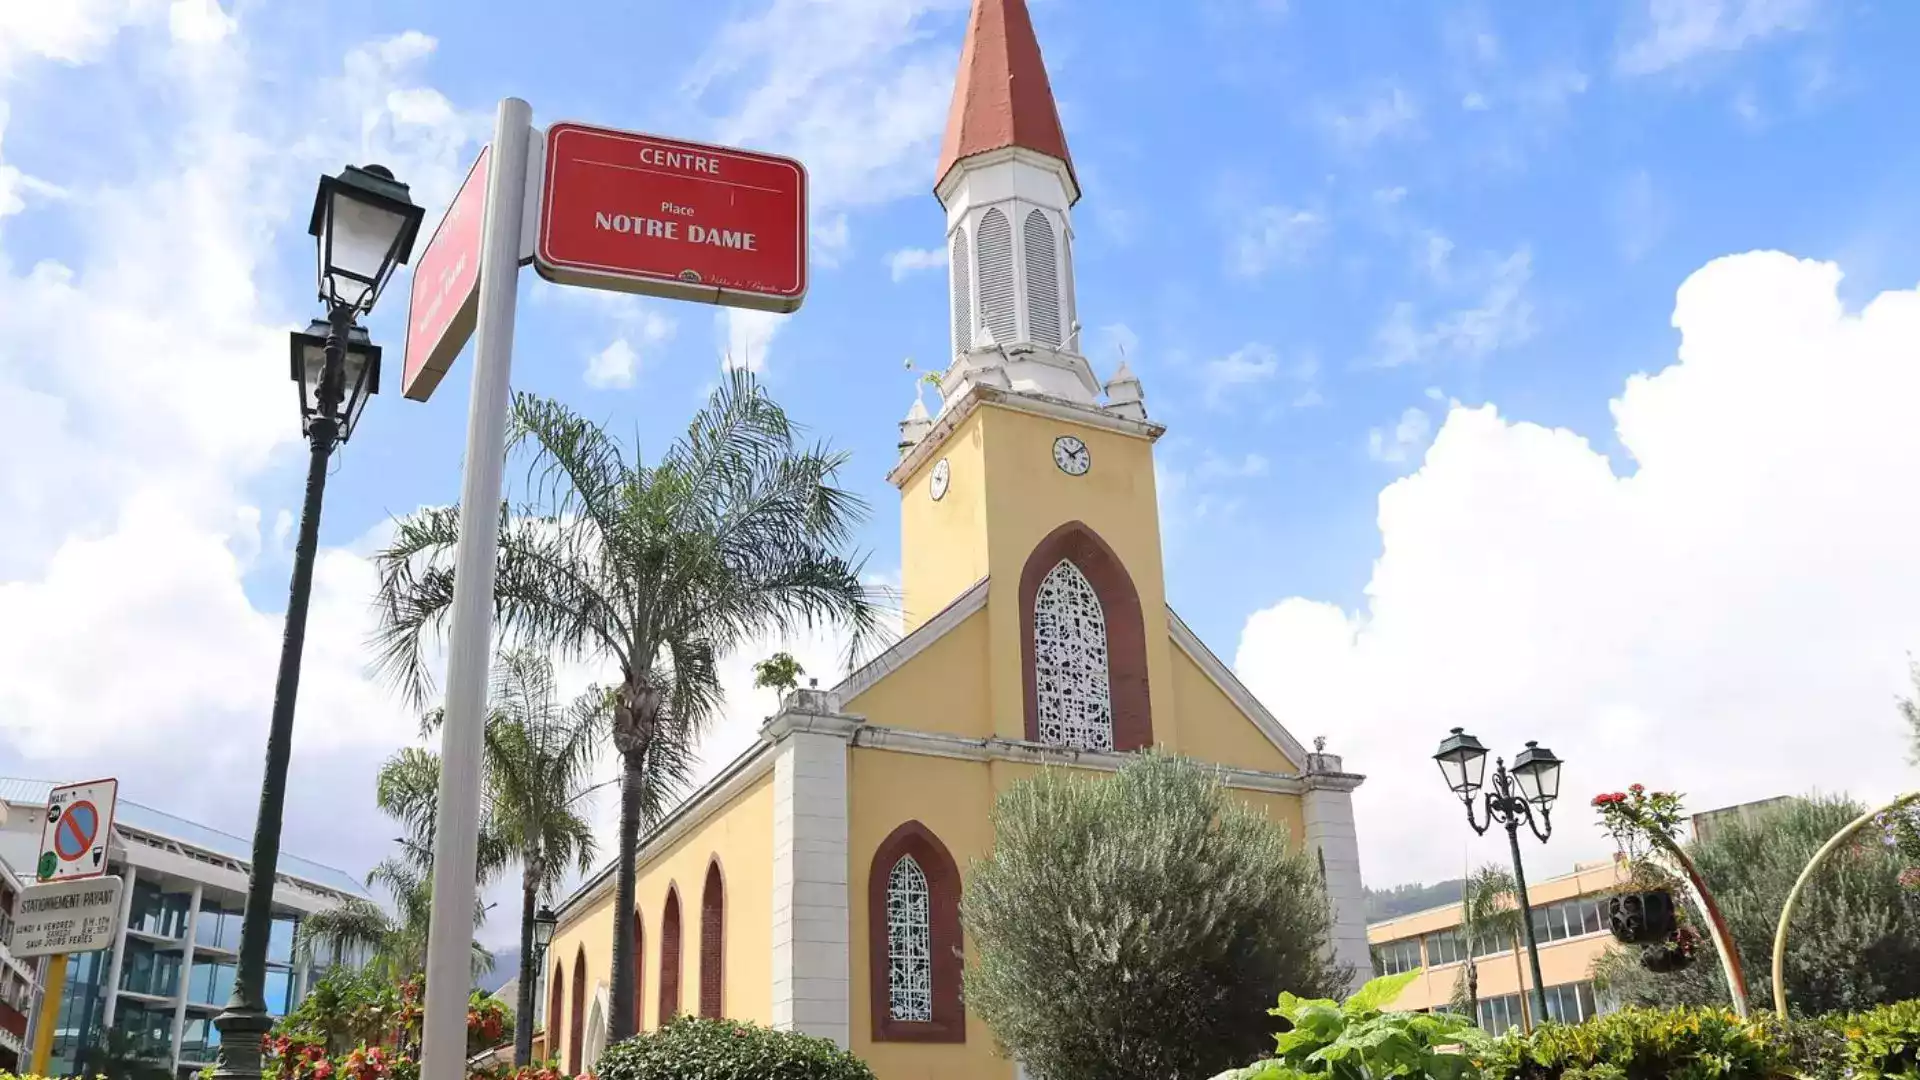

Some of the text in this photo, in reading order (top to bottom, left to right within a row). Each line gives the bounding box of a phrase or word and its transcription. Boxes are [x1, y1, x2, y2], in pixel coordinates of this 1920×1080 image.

[639, 148, 720, 174] CENTRE
[661, 201, 695, 217] Place
[595, 211, 757, 251] NOTRE DAME
[83, 889, 114, 907] PAYANT
[44, 919, 76, 931] VENDREDI
